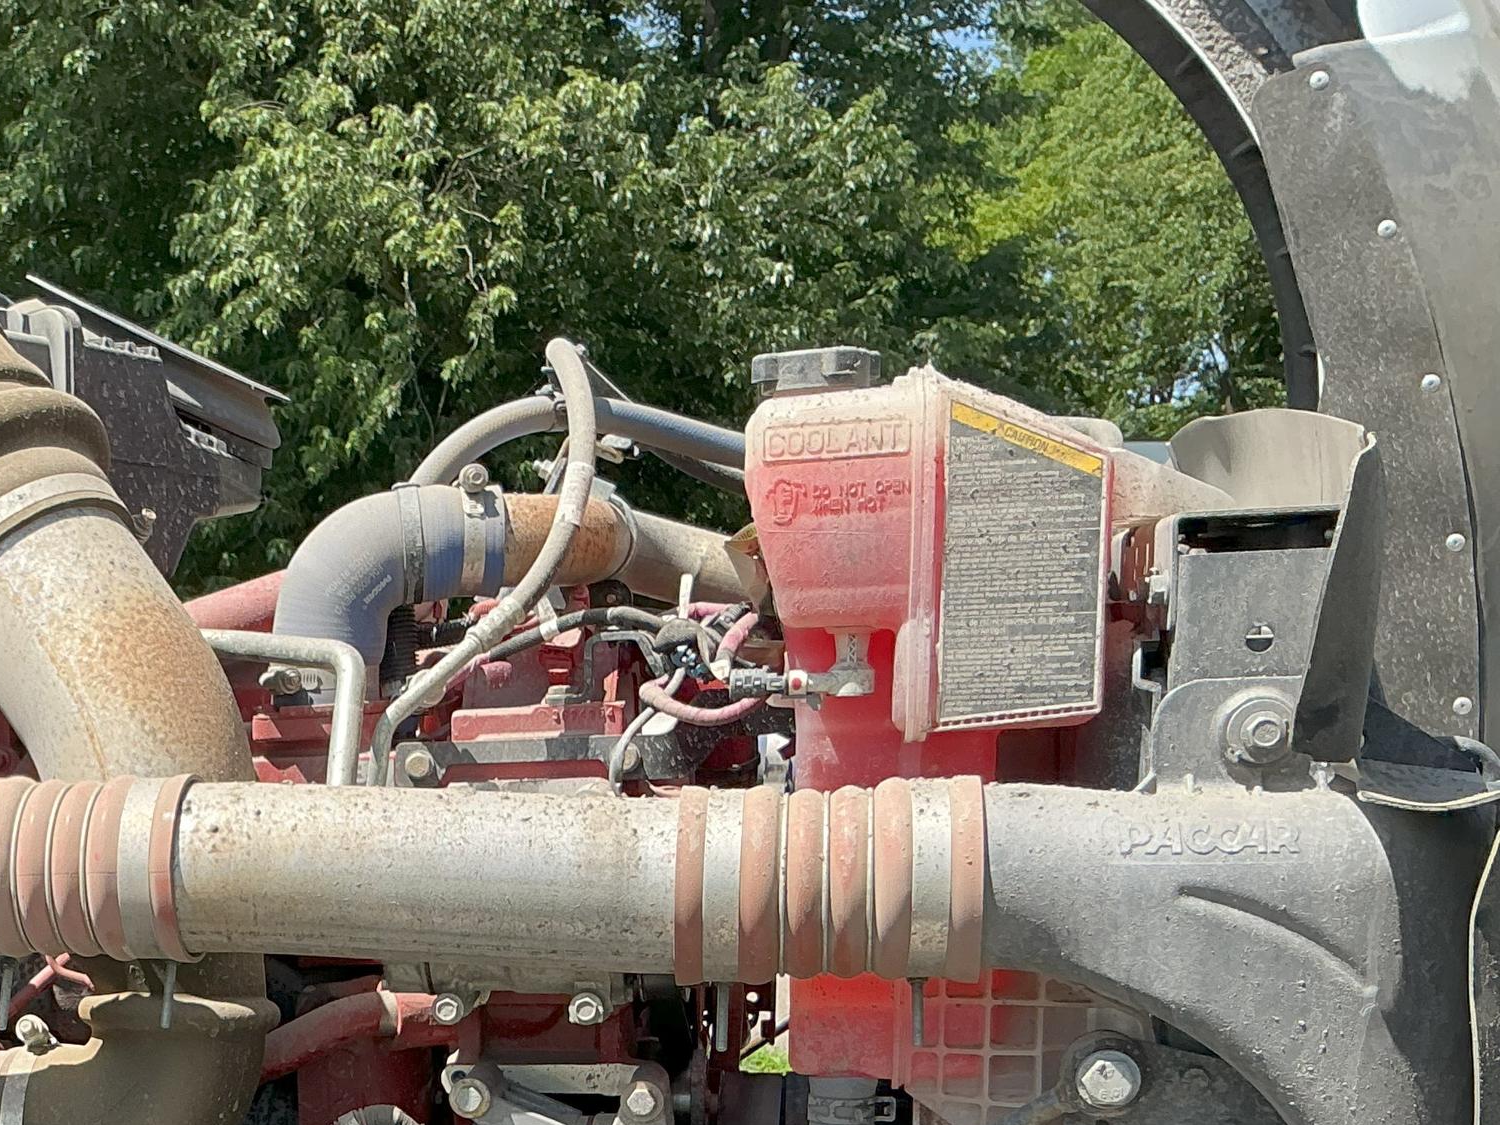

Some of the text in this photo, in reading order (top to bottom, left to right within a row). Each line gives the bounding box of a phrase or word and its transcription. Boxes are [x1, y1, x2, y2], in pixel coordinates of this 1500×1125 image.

[768, 424, 902, 458] COOLANT
[1003, 426, 1050, 453] CAUTION
[812, 479, 912, 499] DO NOT OPEN
[857, 496, 886, 513] HOT
[1119, 822, 1301, 857] PACCAR
